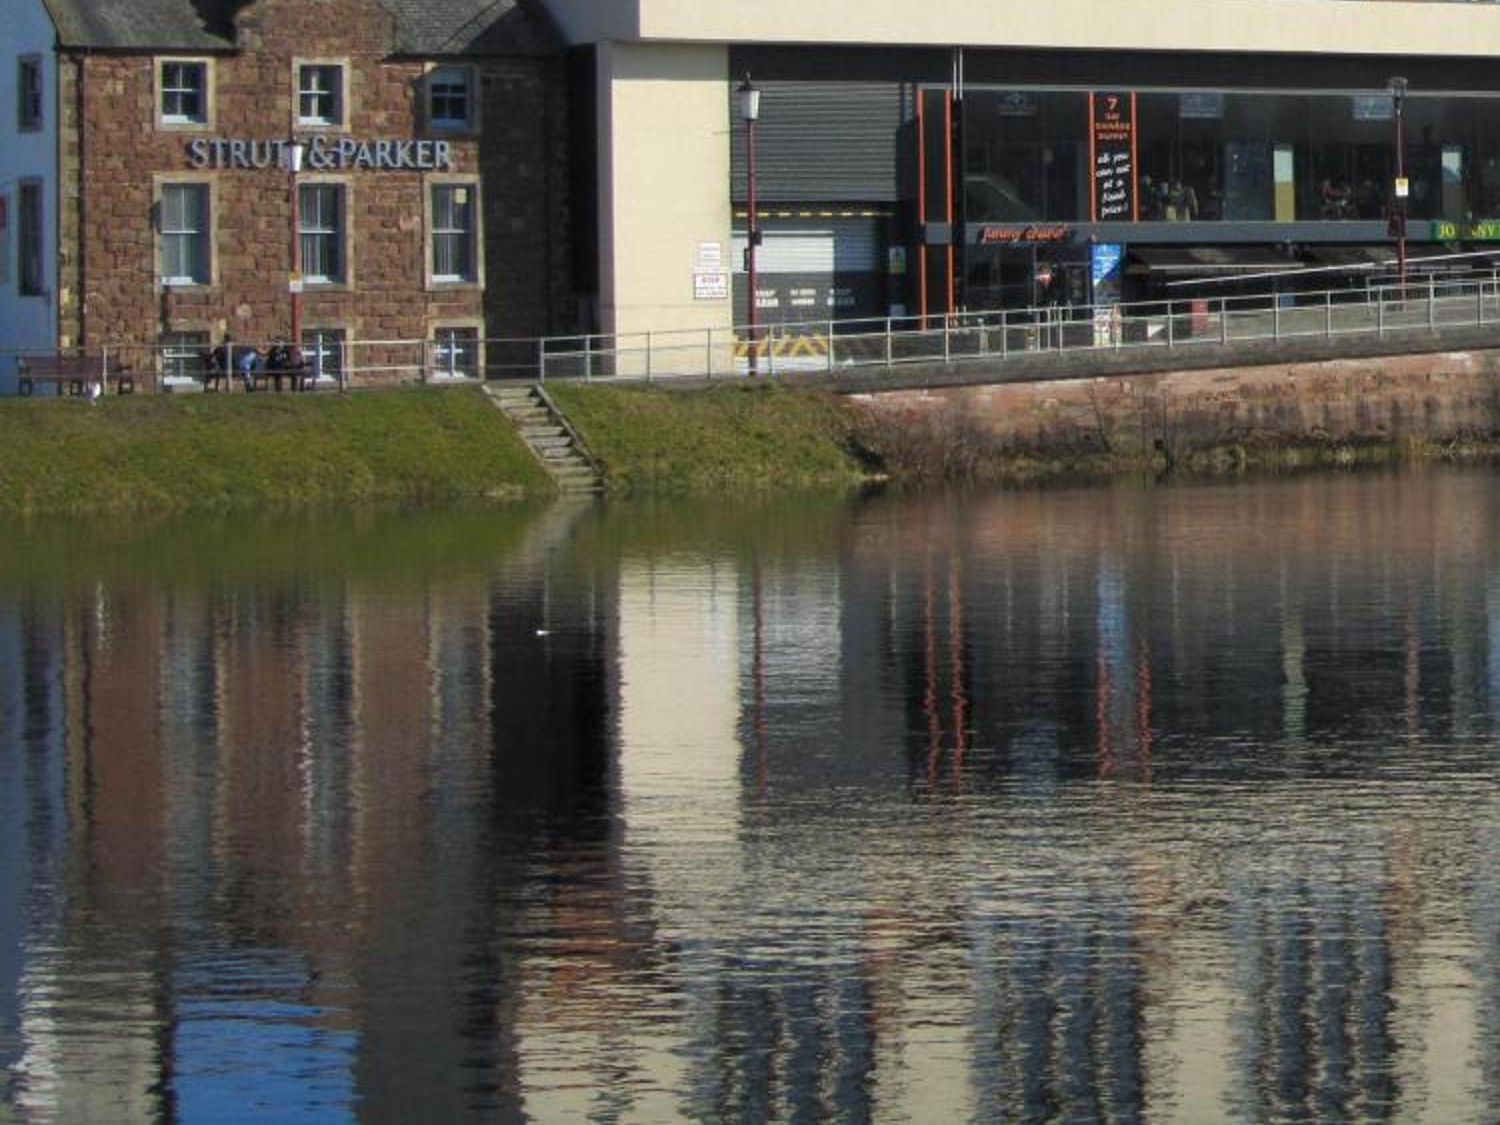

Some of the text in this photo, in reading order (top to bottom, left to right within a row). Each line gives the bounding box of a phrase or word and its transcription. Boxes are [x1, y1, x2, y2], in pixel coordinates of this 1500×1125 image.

[191, 134, 451, 168] STRUT & PARKER
